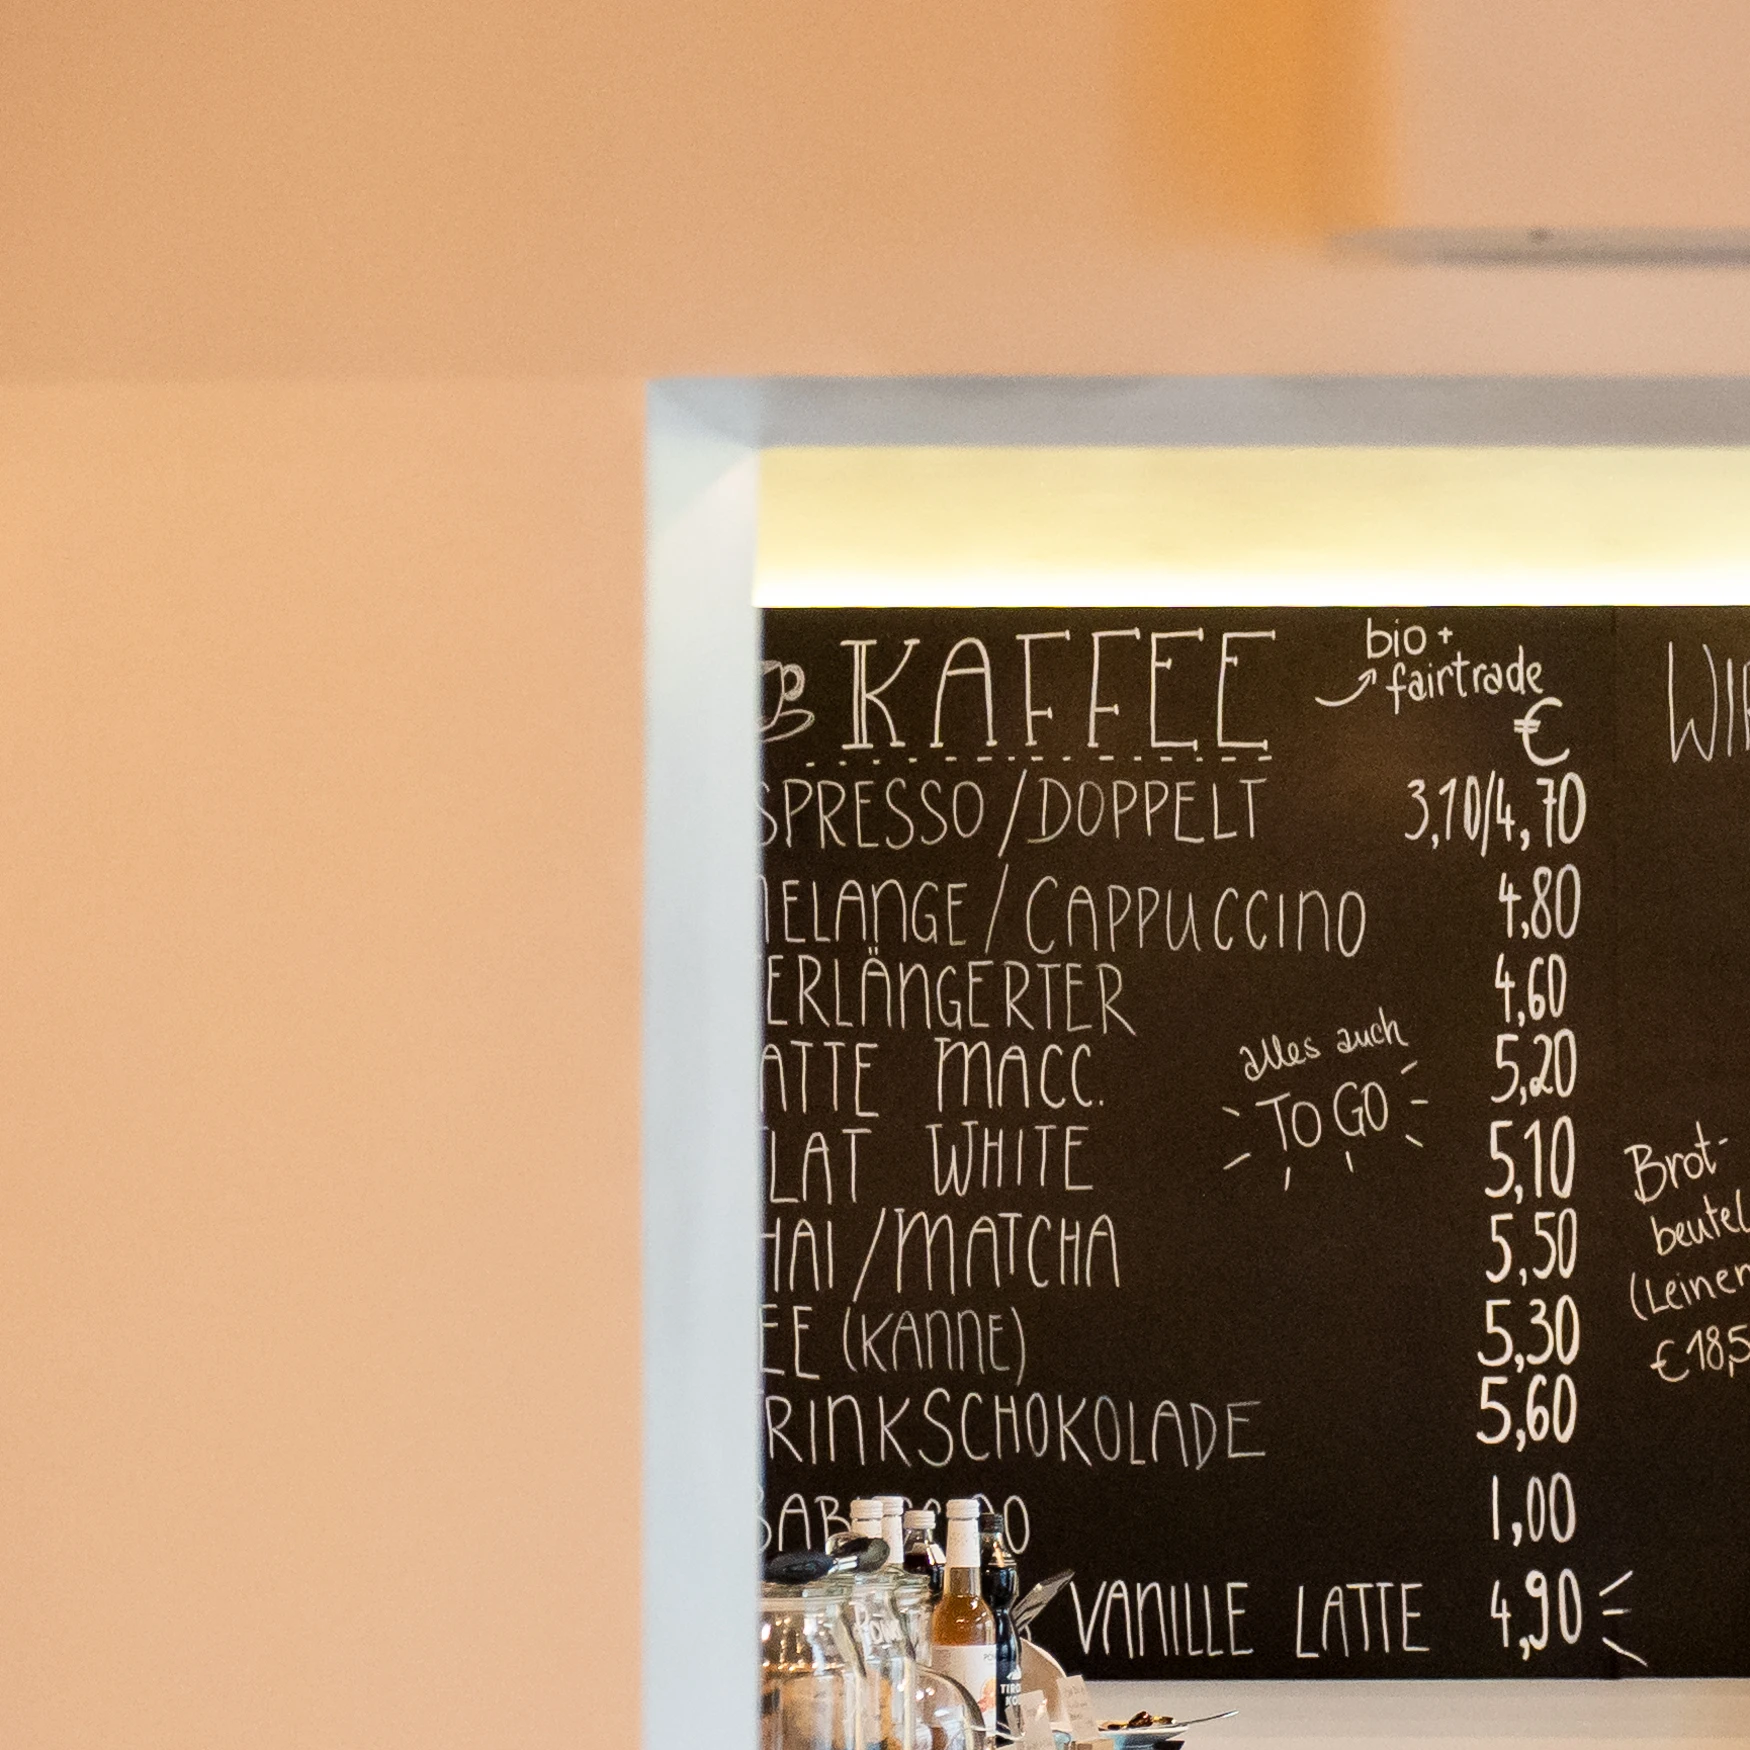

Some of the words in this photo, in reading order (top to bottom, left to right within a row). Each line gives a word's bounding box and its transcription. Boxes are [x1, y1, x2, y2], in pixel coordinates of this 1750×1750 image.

[1367, 618, 1426, 658] bio
[841, 628, 1275, 750] KAFFEE
[1385, 645, 1546, 716] fairtrade
[1499, 864, 1581, 939] 4,80
[1495, 953, 1566, 1027] 4,60
[935, 1037, 1103, 1112] MACC.
[1240, 1035, 1320, 1081] alles
[1337, 1007, 1408, 1053] auch
[1491, 1029, 1576, 1105] 5,20
[1333, 1082, 1388, 1136] GO
[926, 1121, 1092, 1196] WHITE
[1485, 1116, 1575, 1203] 5,10
[1486, 1208, 1577, 1286] 5,50
[843, 1307, 1025, 1385] (KANNE)
[1478, 1295, 1579, 1372] 5,30
[1477, 1374, 1576, 1452] 5,60
[1492, 1472, 1575, 1546] 1,00
[1070, 1580, 1253, 1658] VANILLE
[1296, 1582, 1429, 1657] LATTE
[1491, 1568, 1582, 1660] 4,90
